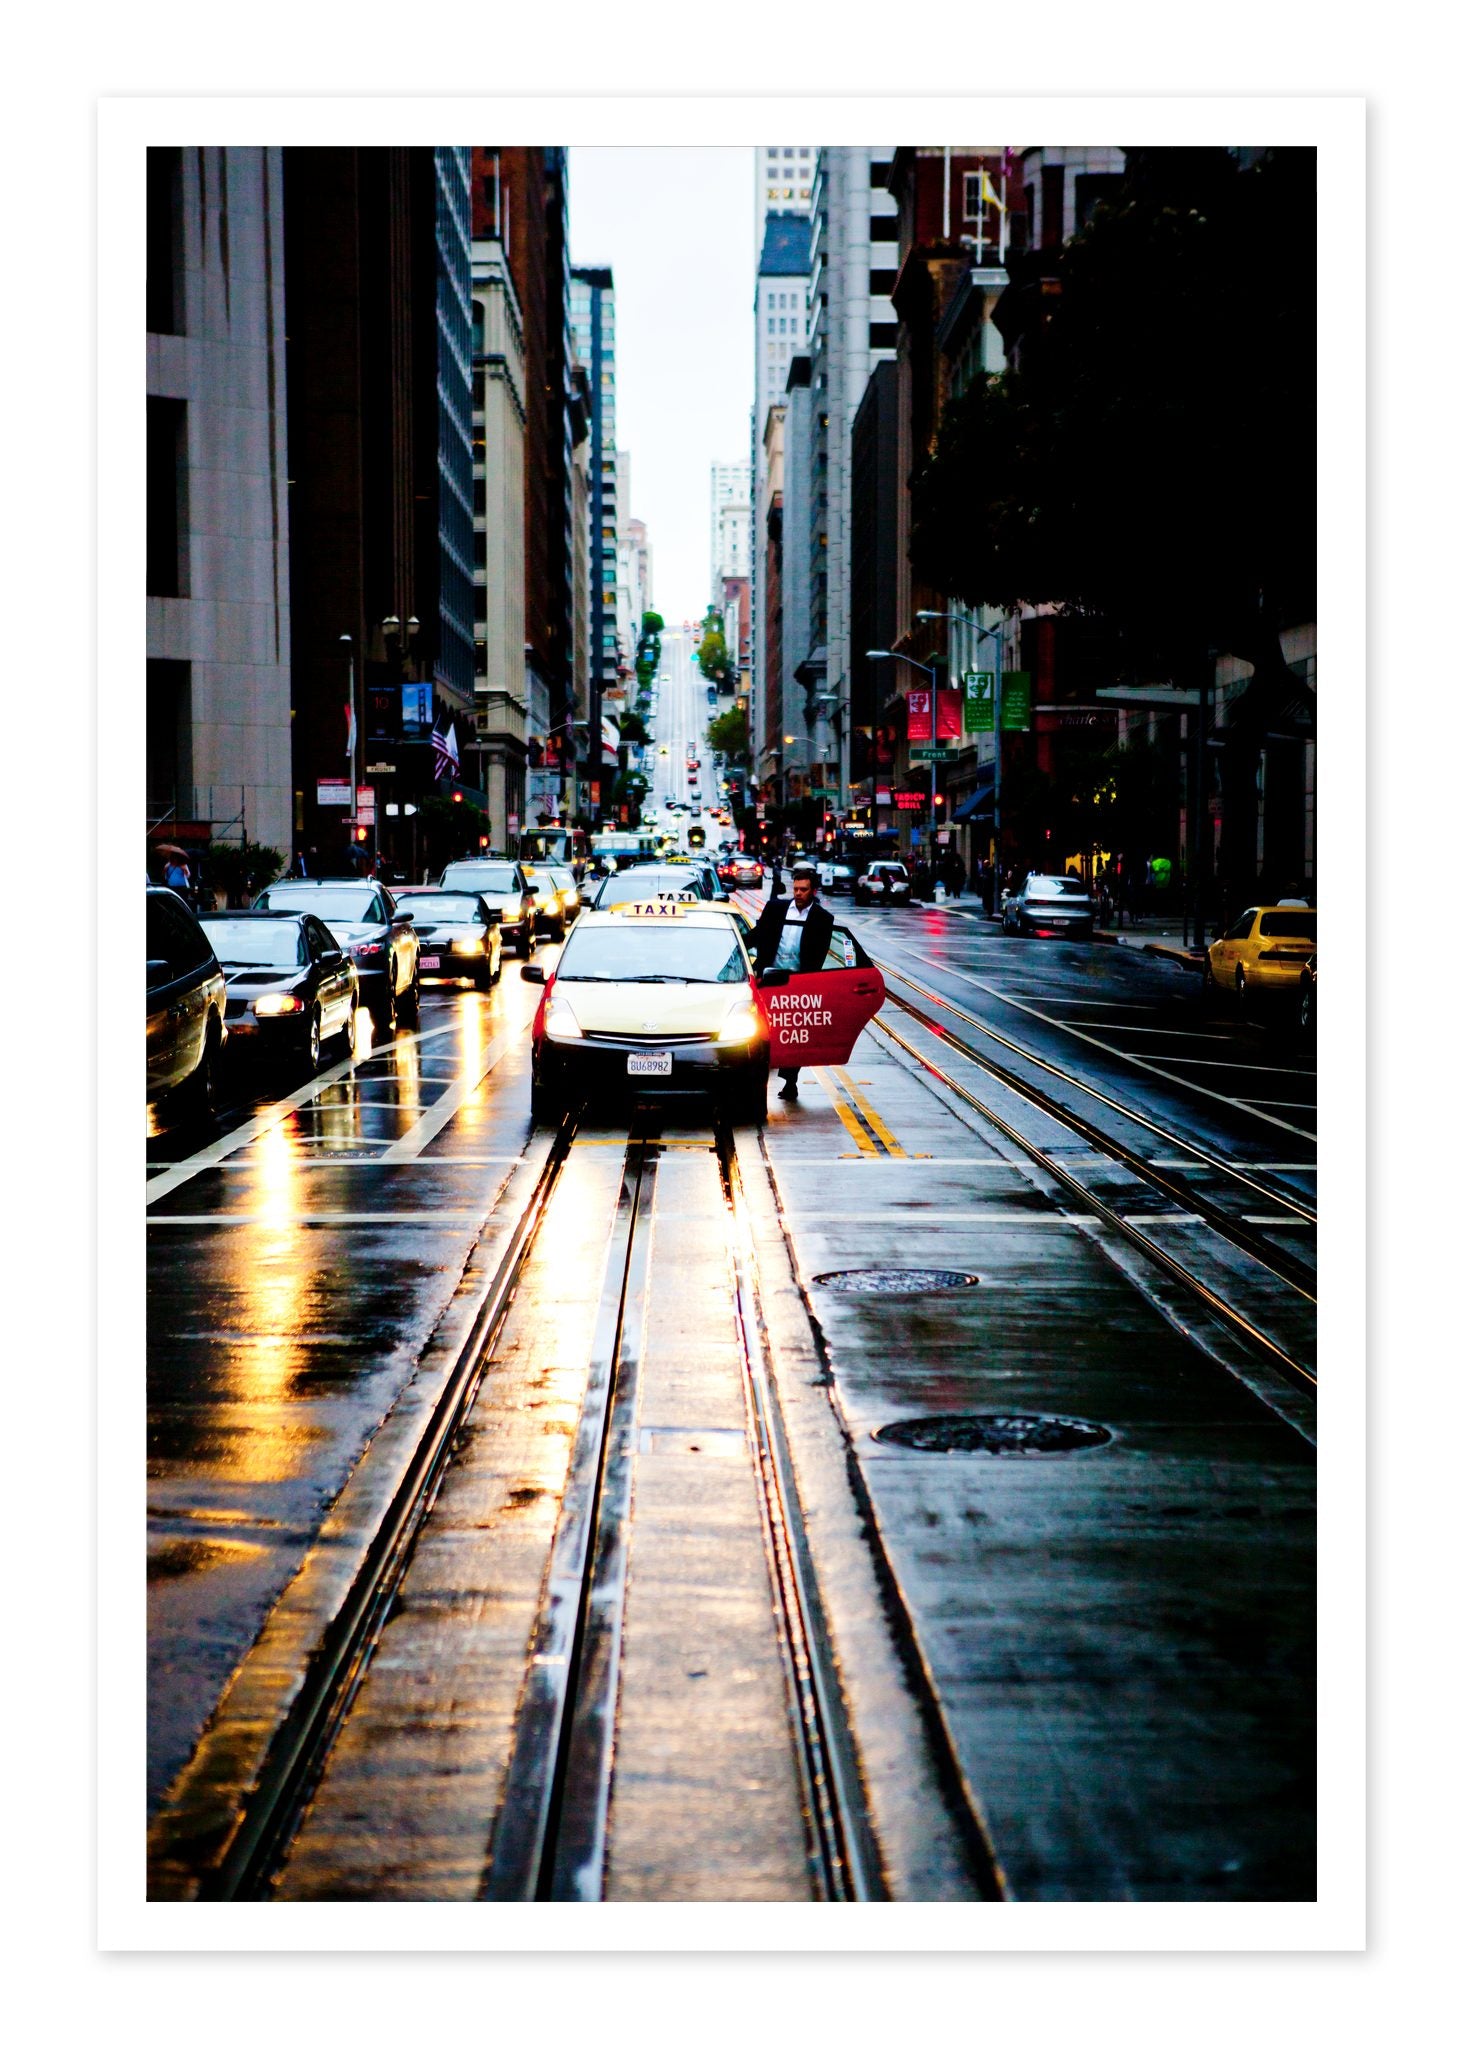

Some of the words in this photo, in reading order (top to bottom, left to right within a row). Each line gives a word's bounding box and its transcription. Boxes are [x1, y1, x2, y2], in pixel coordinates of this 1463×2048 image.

[893, 791, 926, 801] TADICH
[897, 801, 921, 810] GRILL
[657, 893, 692, 902] TAXI
[633, 904, 676, 915] TAXI
[769, 994, 823, 1010] ARROW
[779, 1029, 810, 1044] CAB
